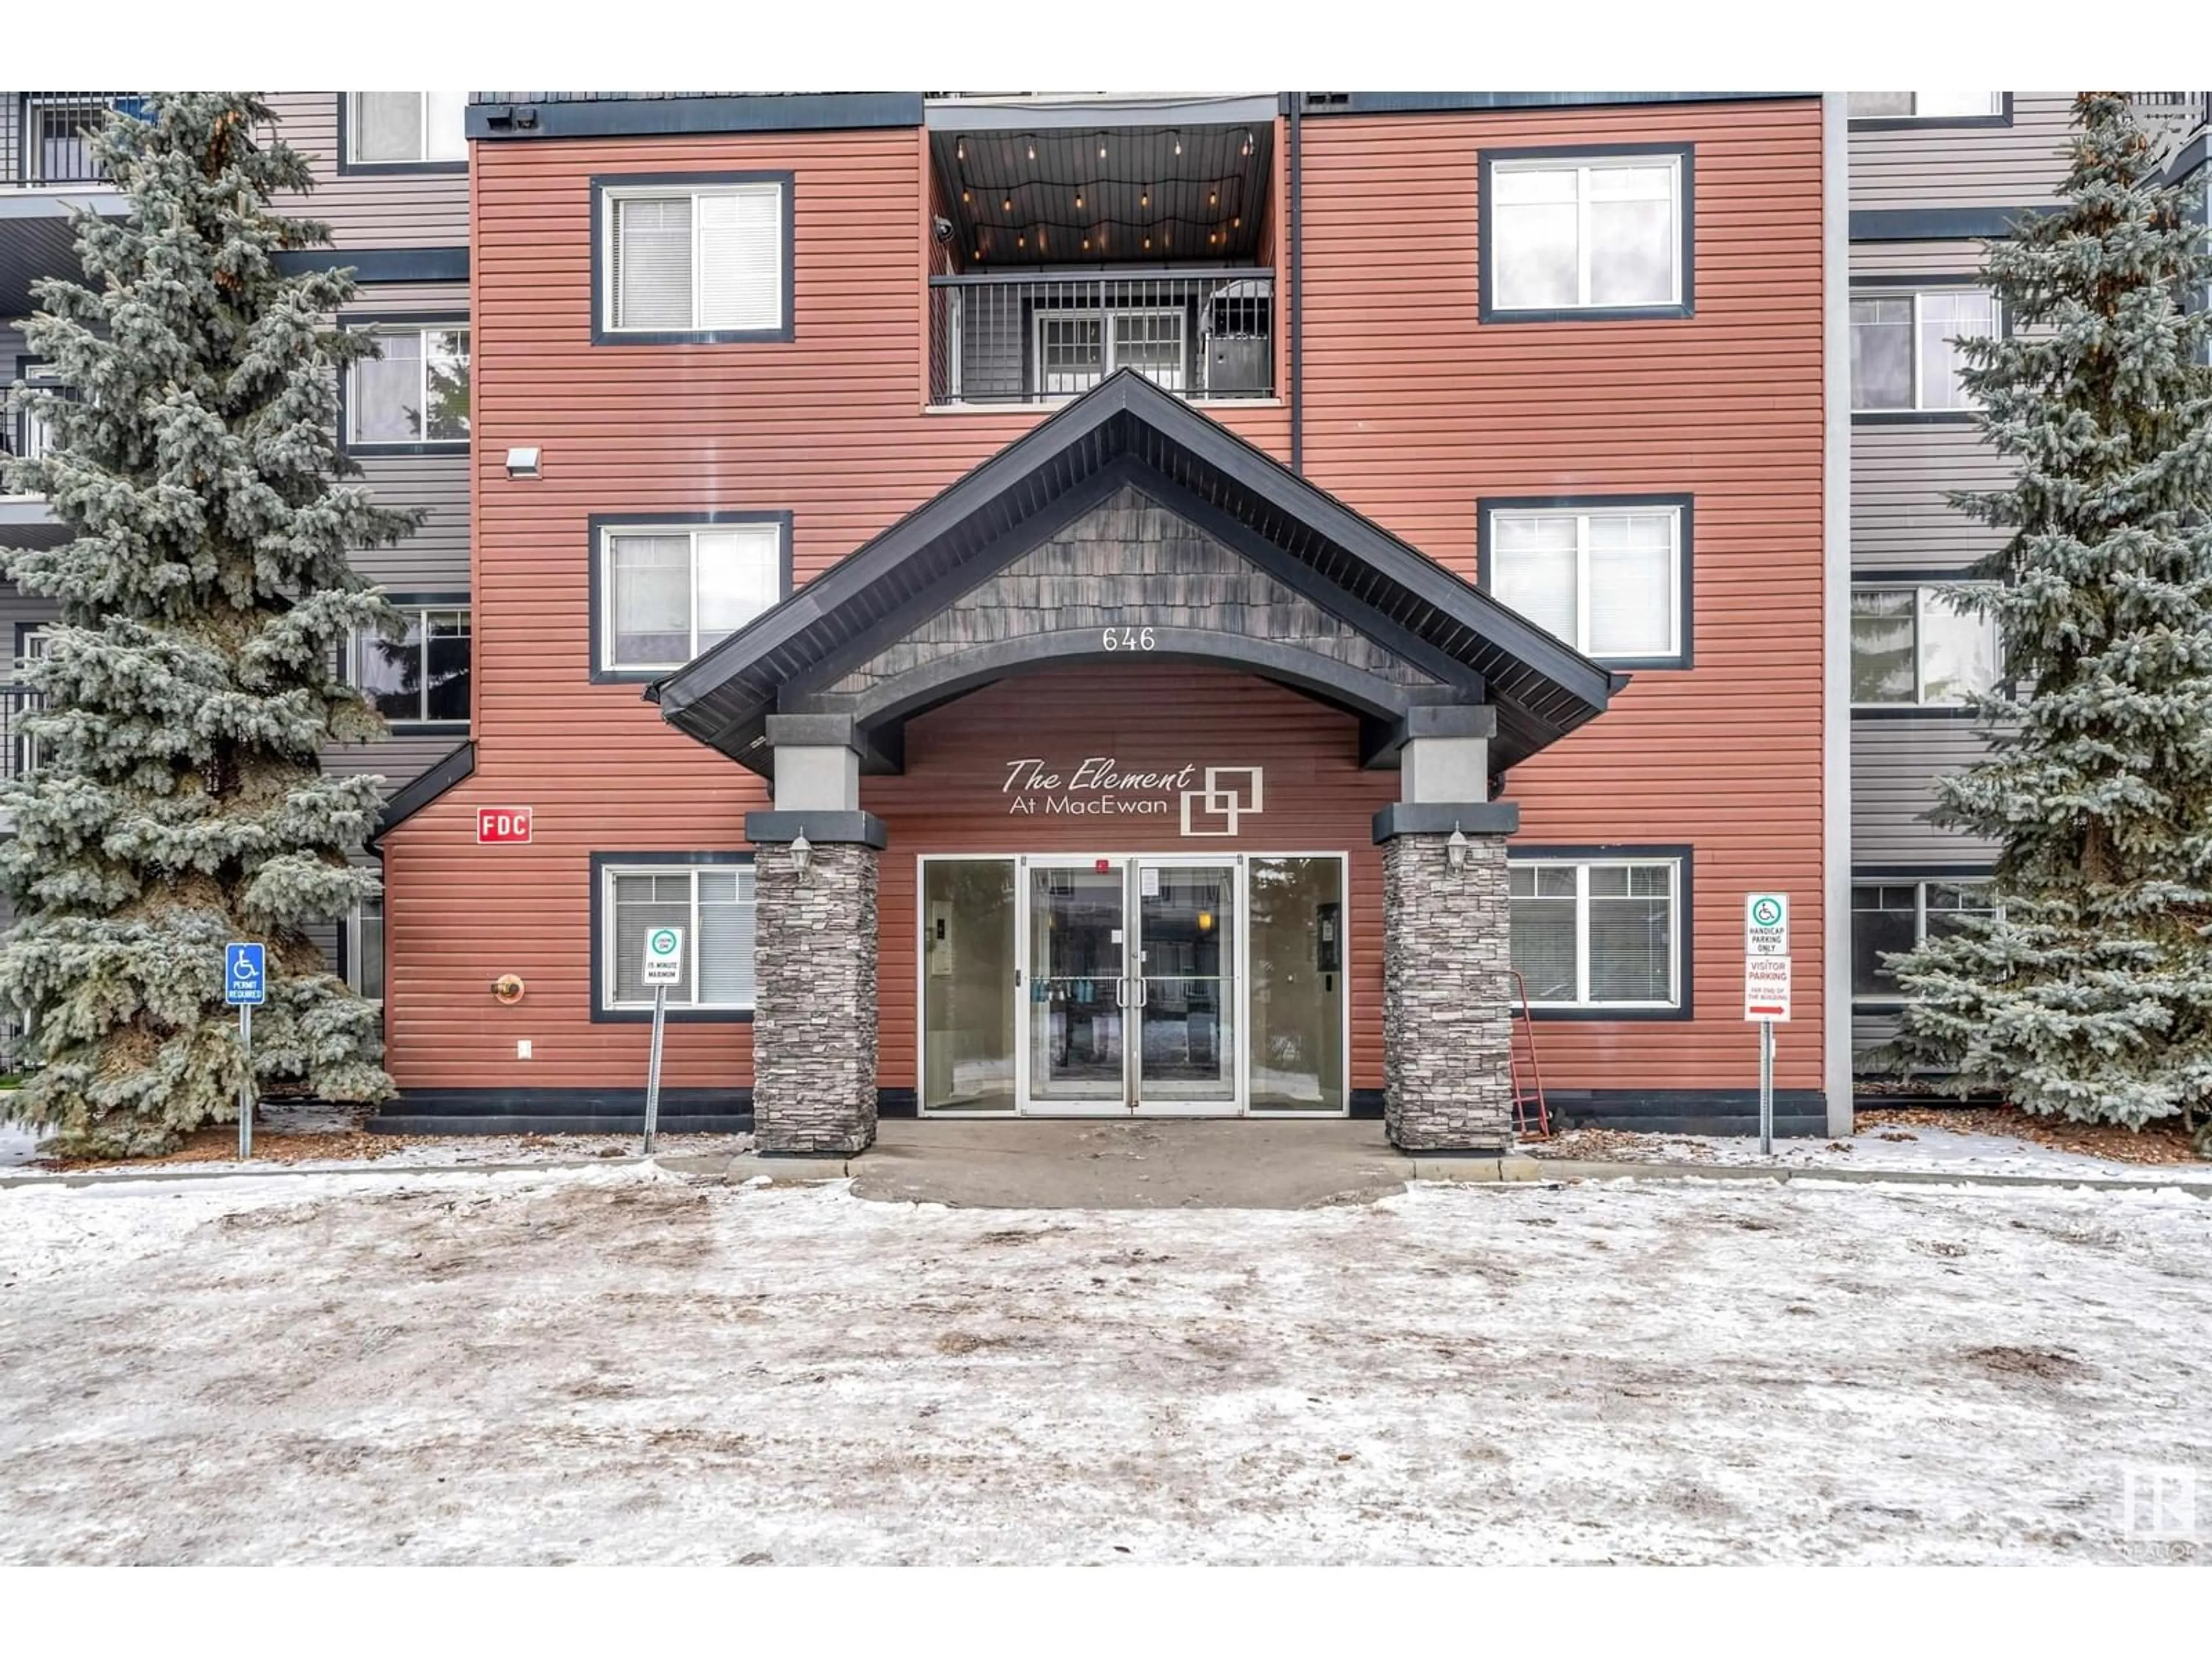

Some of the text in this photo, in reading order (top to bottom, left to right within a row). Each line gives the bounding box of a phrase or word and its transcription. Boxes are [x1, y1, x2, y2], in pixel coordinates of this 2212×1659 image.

[1103, 627, 1156, 651] 646
[1002, 757, 1196, 793] The Element
[1009, 794, 1168, 815] At MacEwan
[482, 815, 526, 836] FDC
[1749, 927, 1785, 935] HANDICAP
[1751, 935, 1782, 944] PARKING
[1757, 944, 1776, 952] ONLY
[1751, 961, 1786, 971] VISITOR
[1748, 972, 1787, 981] PARKING
[233, 981, 257, 989] PERMIT
[229, 990, 262, 998] REQUIRED
